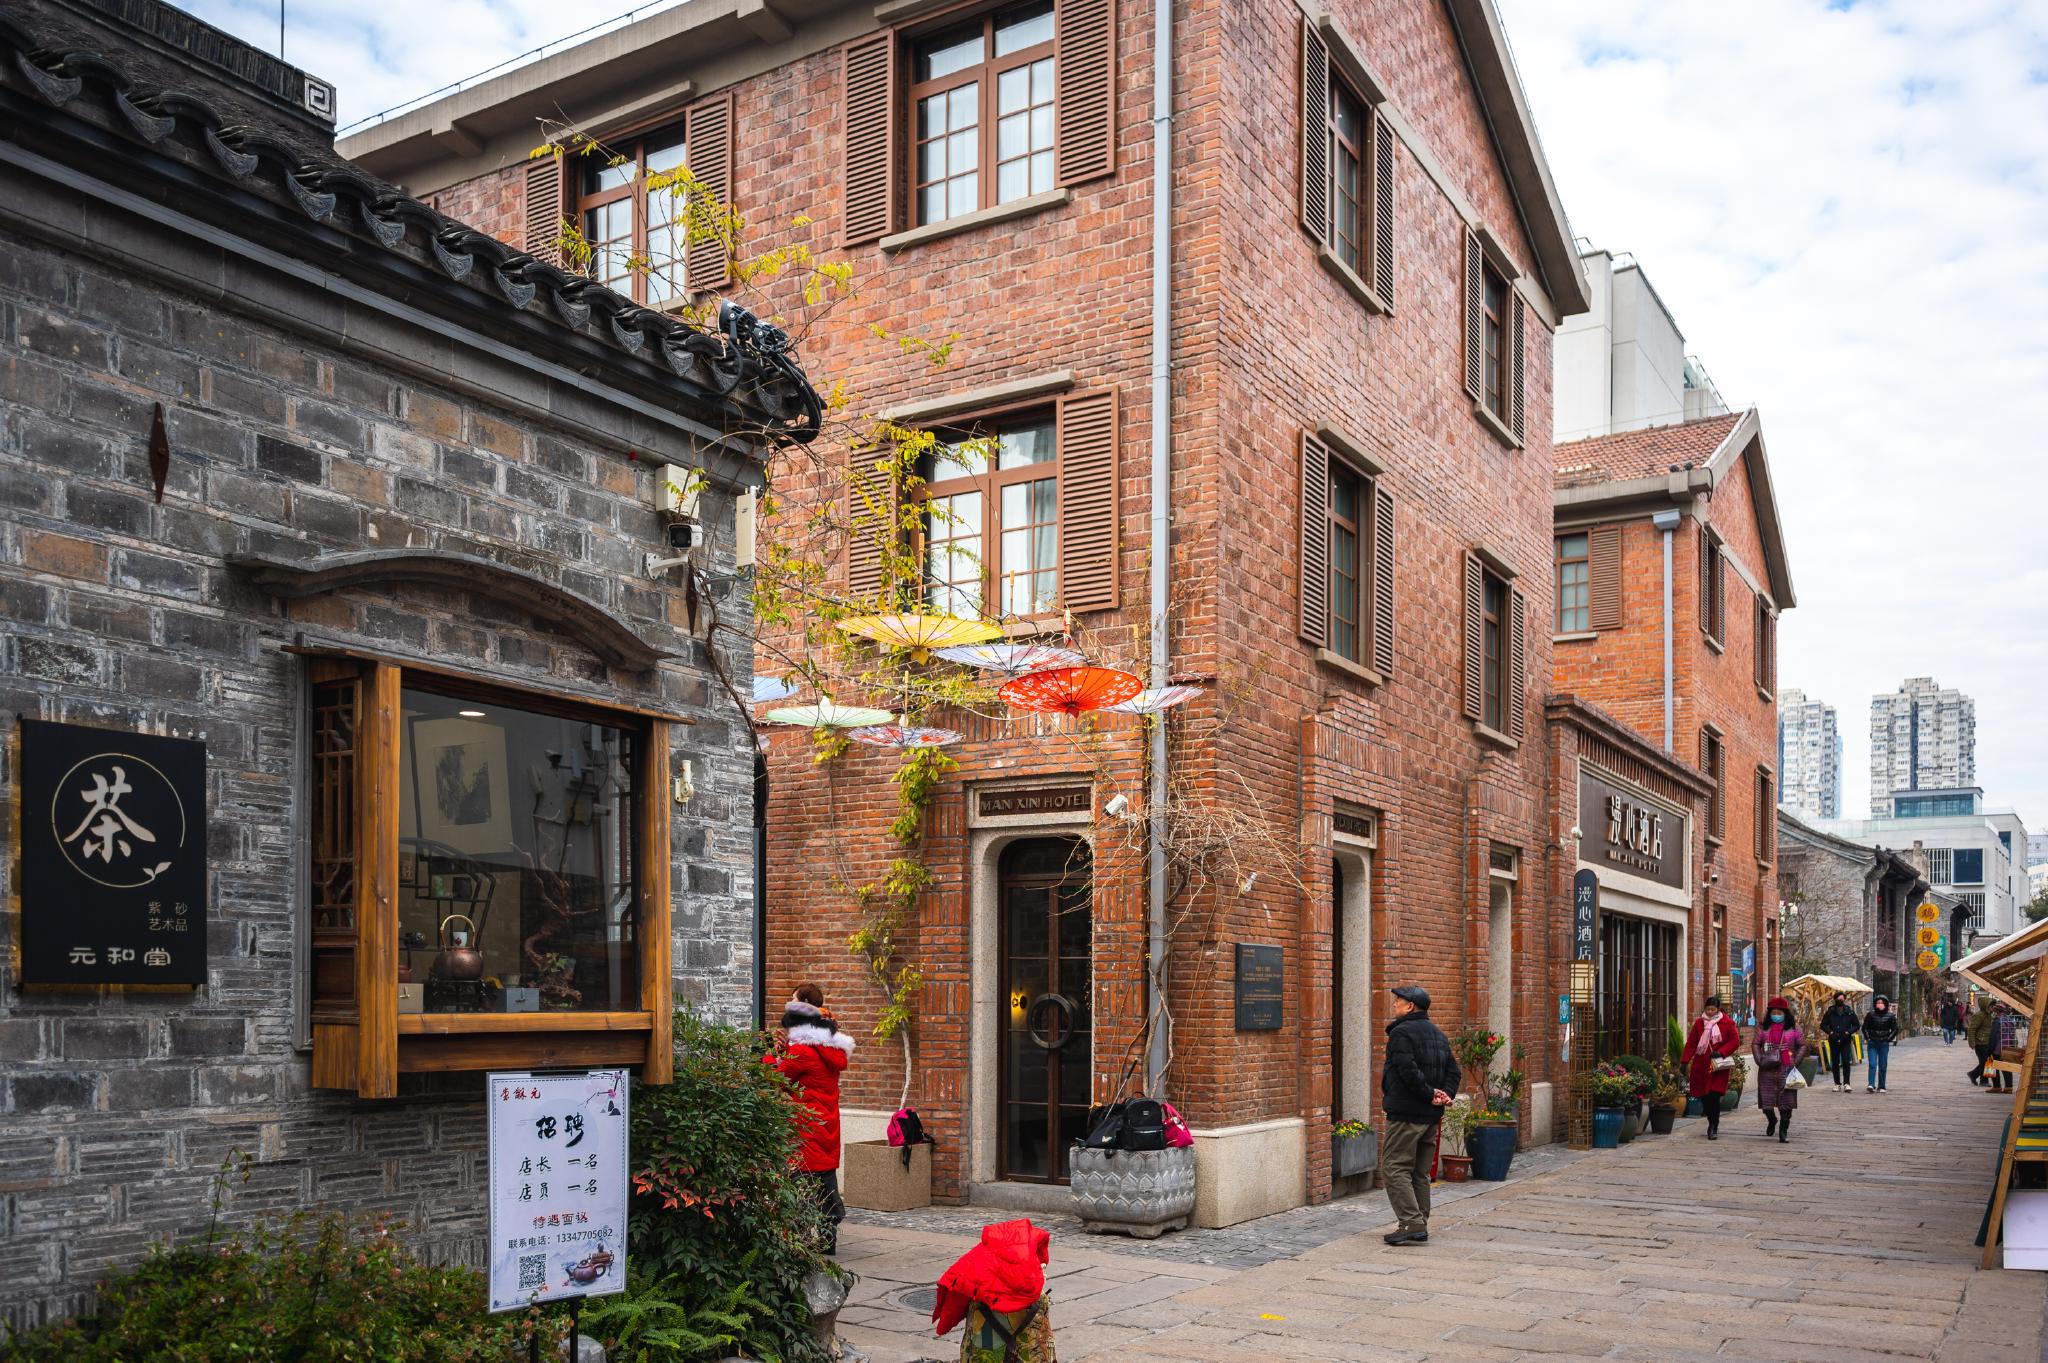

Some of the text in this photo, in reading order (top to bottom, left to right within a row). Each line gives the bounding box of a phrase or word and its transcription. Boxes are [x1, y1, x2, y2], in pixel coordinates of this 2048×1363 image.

[980, 793, 1091, 811] MAN XIN HOTEL
[64, 766, 156, 864] 茶
[1610, 795, 1662, 860] 漫心酒店
[148, 901, 188, 916] 紫砂
[148, 918, 188, 932] 艺术品
[1578, 886, 1592, 961] 漫心酒店
[69, 947, 172, 966] 元和堂
[535, 1112, 585, 1148] 招聘
[519, 1153, 598, 1174] 店长 一名
[519, 1179, 598, 1201] 店员 一名
[532, 1212, 588, 1228] 待遇面议
[556, 1228, 613, 1243] 13347705082
